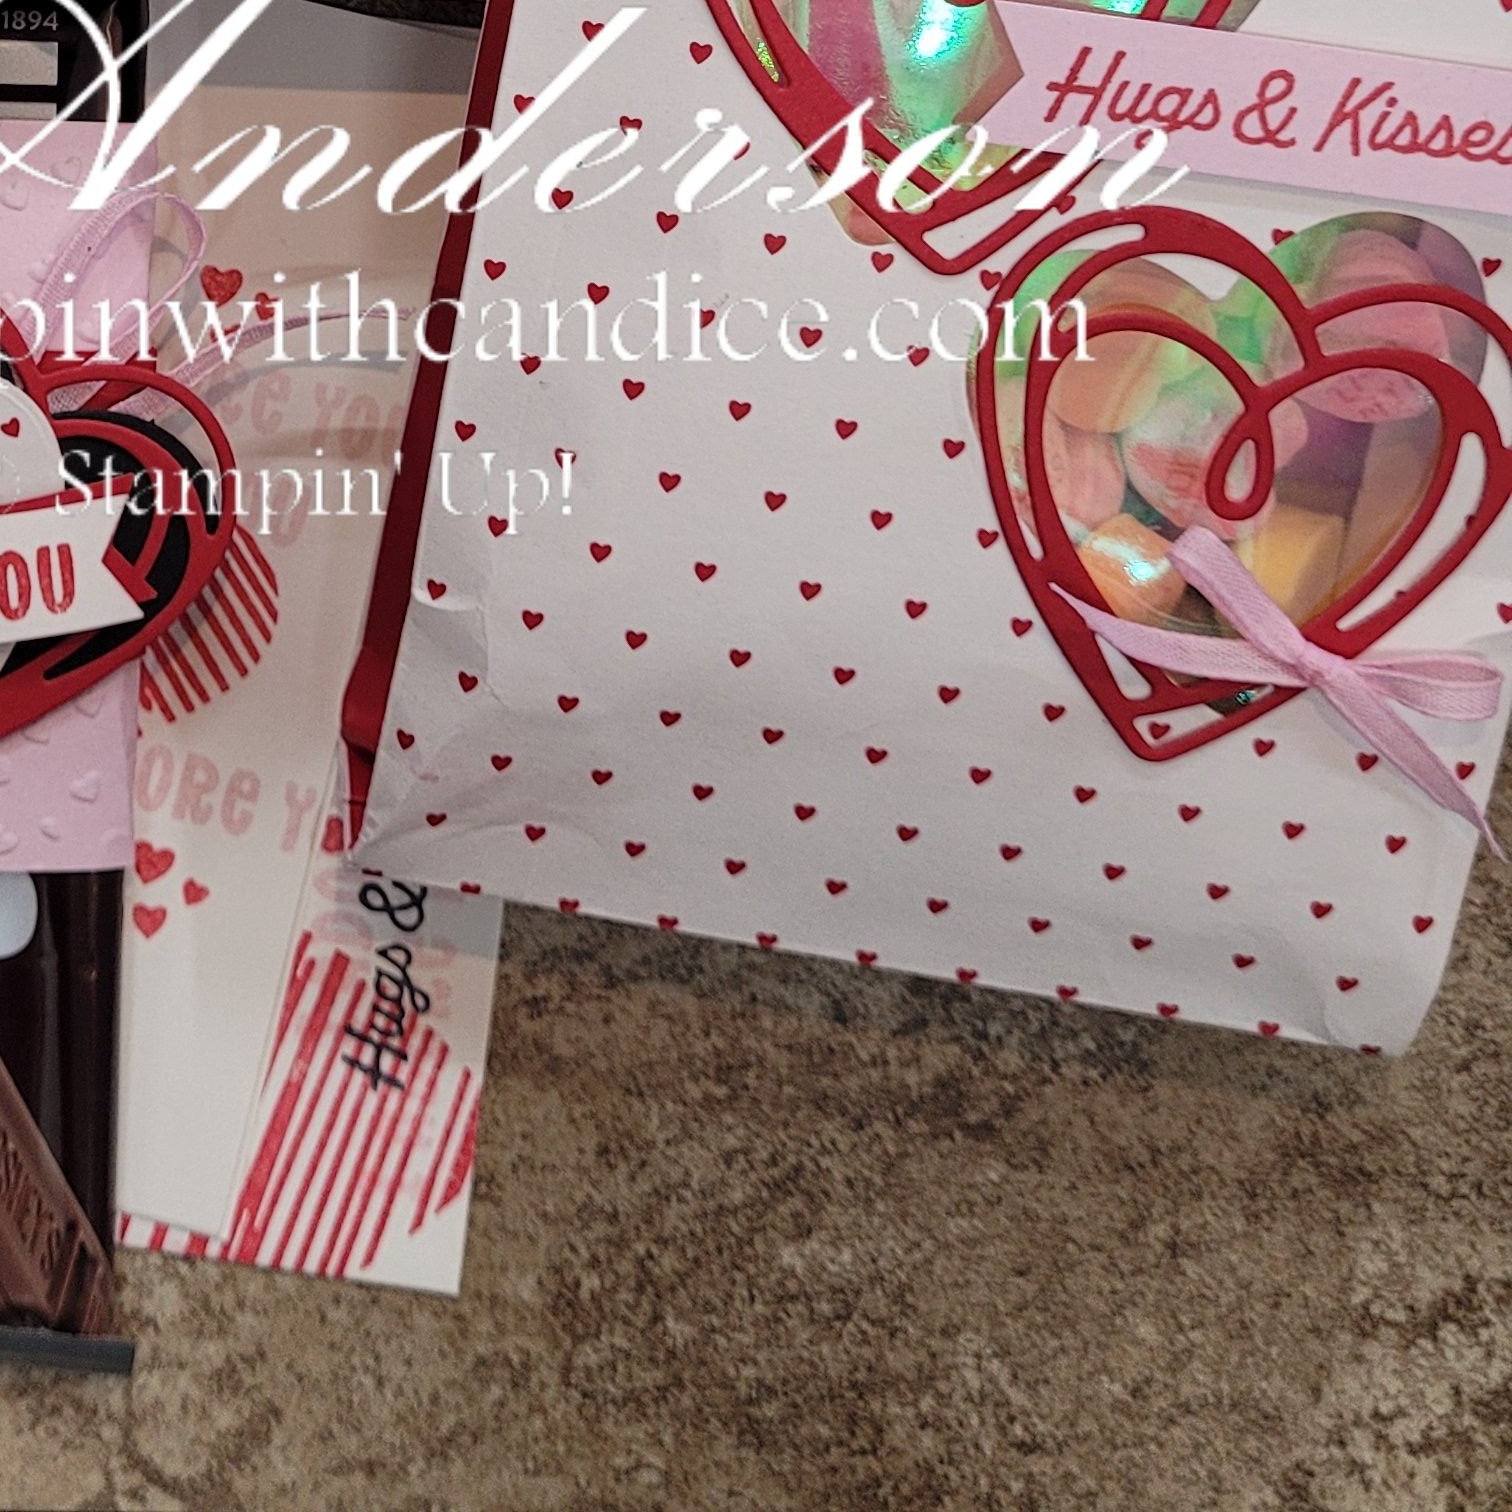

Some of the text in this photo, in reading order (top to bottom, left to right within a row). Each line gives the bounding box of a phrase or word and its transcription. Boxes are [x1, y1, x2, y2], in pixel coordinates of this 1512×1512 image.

[1, 10, 59, 31] 1894
[1044, 47, 1222, 151] Hugs
[1233, 69, 1298, 149] &
[341, 943, 431, 1091] Hugs
